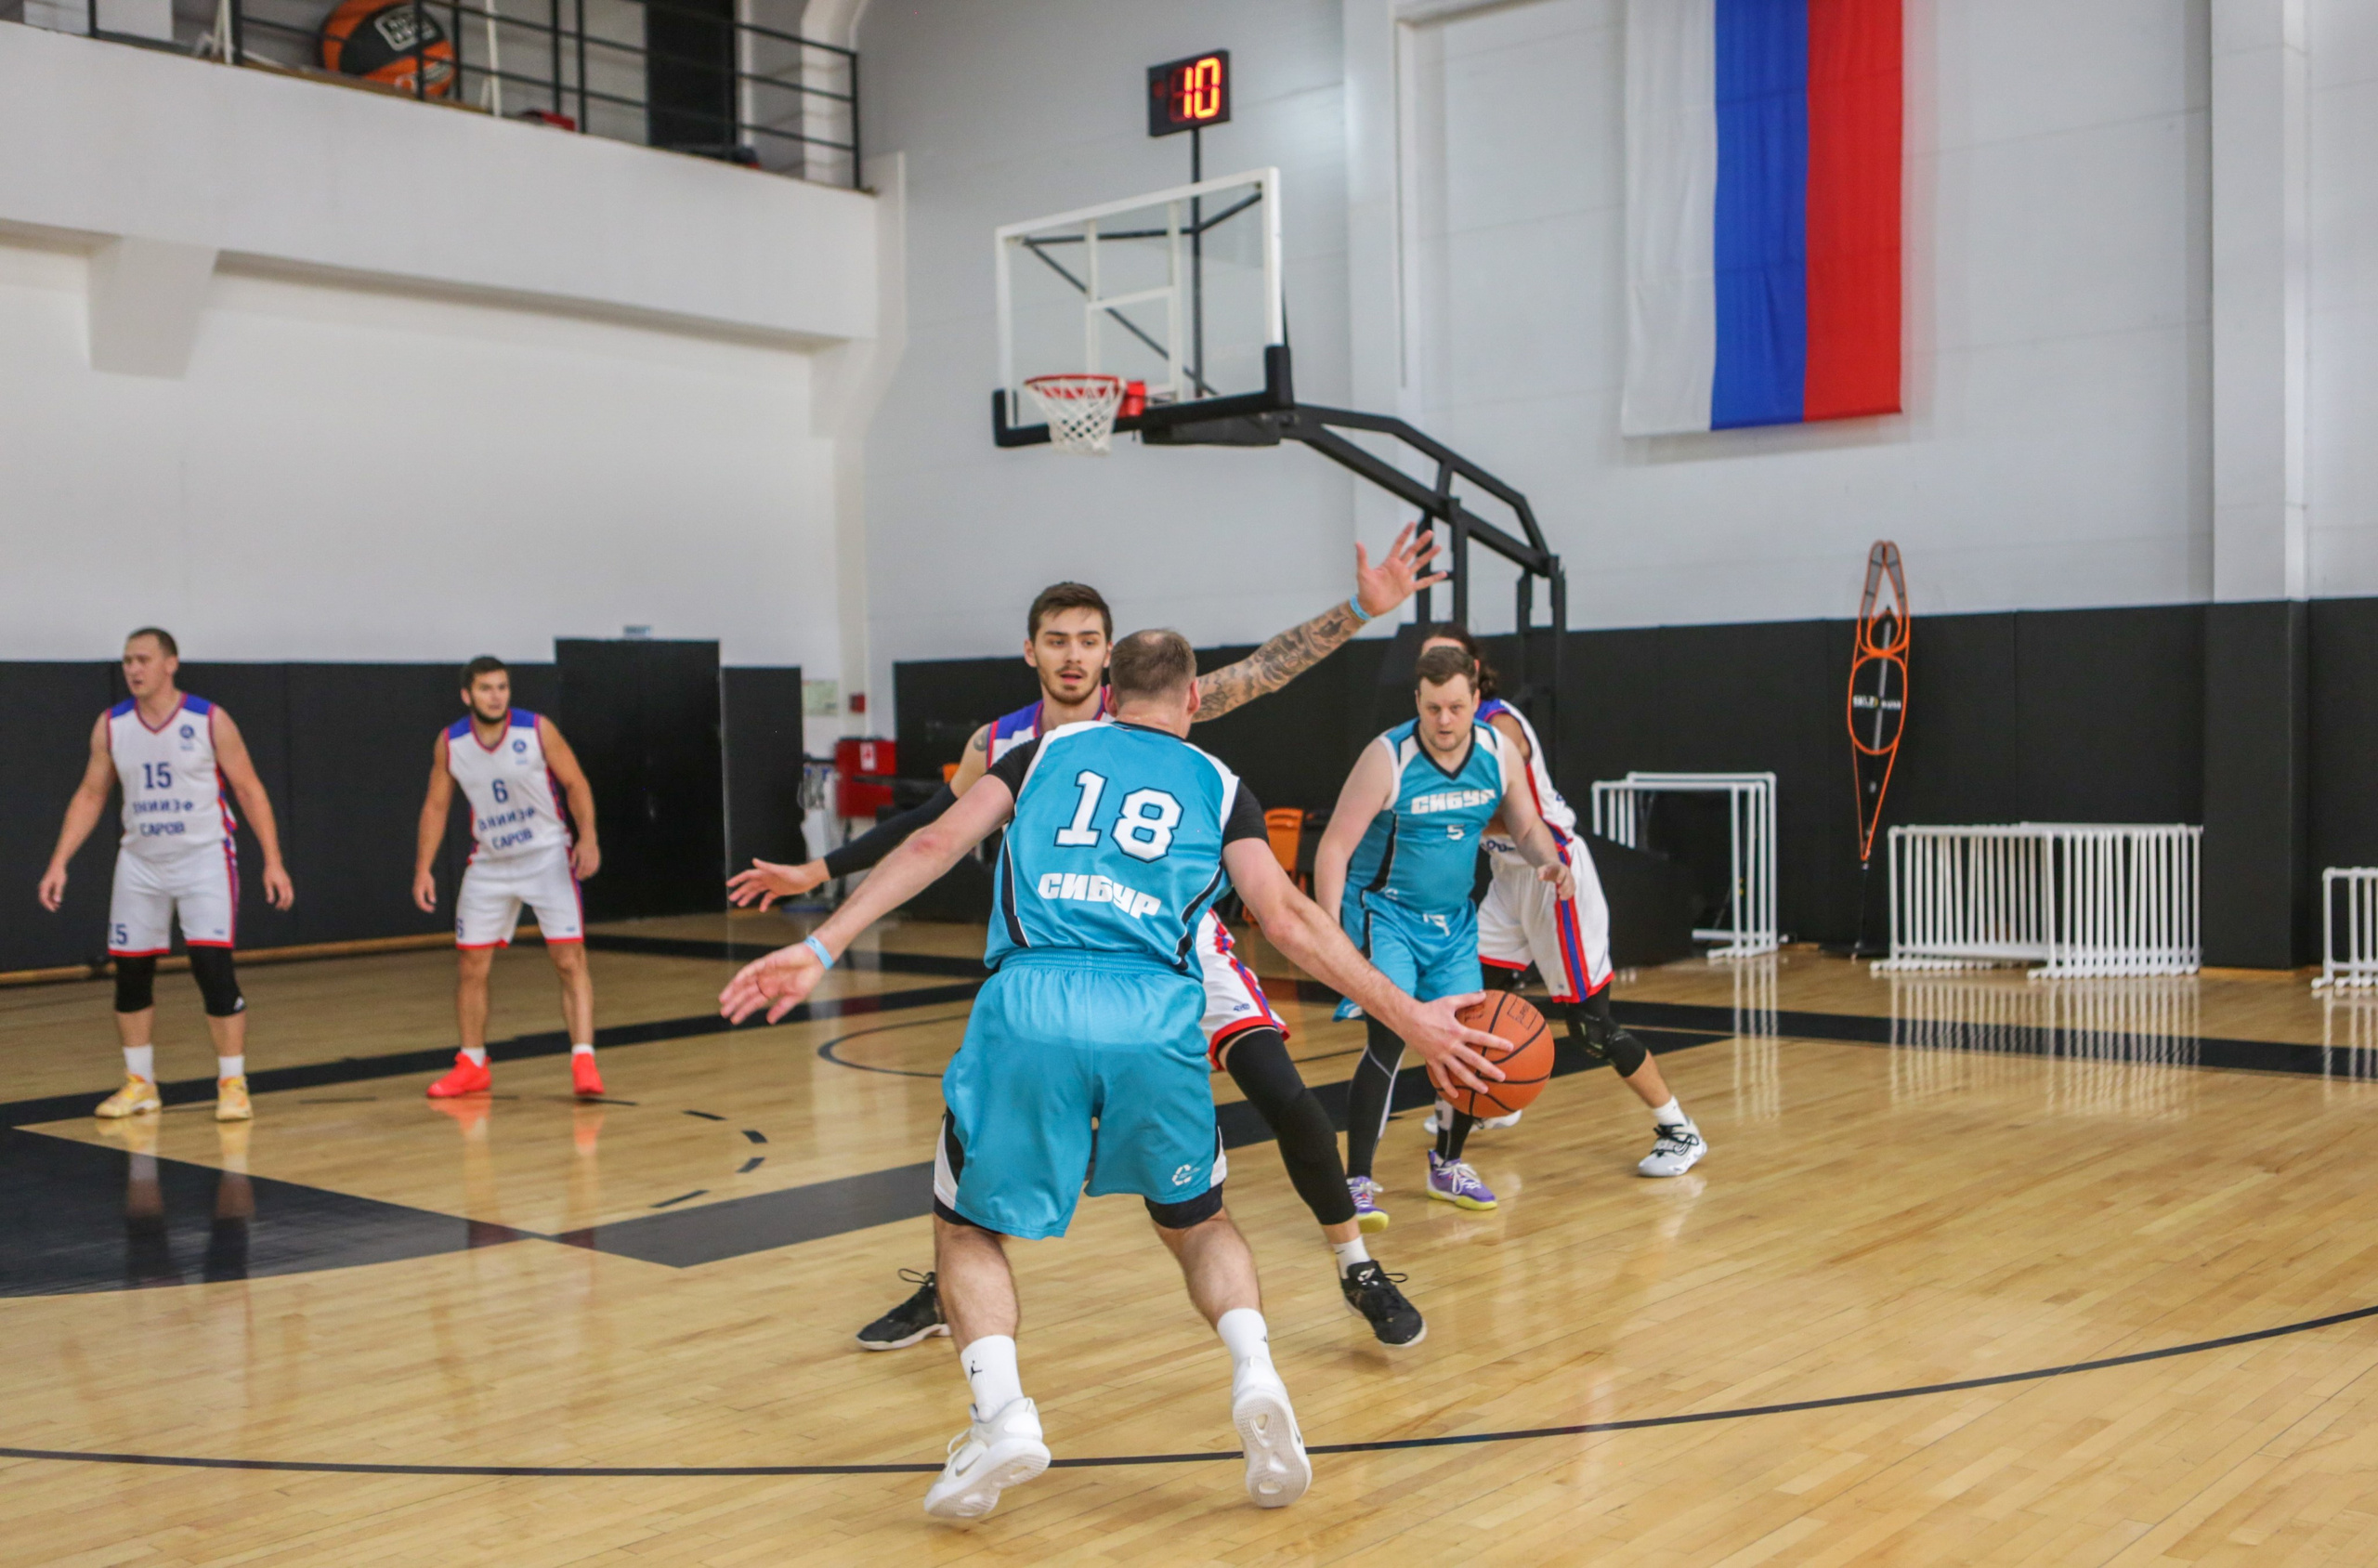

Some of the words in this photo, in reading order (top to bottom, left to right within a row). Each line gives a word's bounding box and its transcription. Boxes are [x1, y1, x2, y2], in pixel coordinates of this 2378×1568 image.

[1182, 57, 1222, 119] 10
[142, 762, 173, 790] 15
[491, 778, 508, 804] 6
[1053, 768, 1184, 864] 18
[491, 828, 533, 850] САРОВ
[1446, 824, 1465, 840] 5
[1038, 872, 1162, 920] СИБУР
